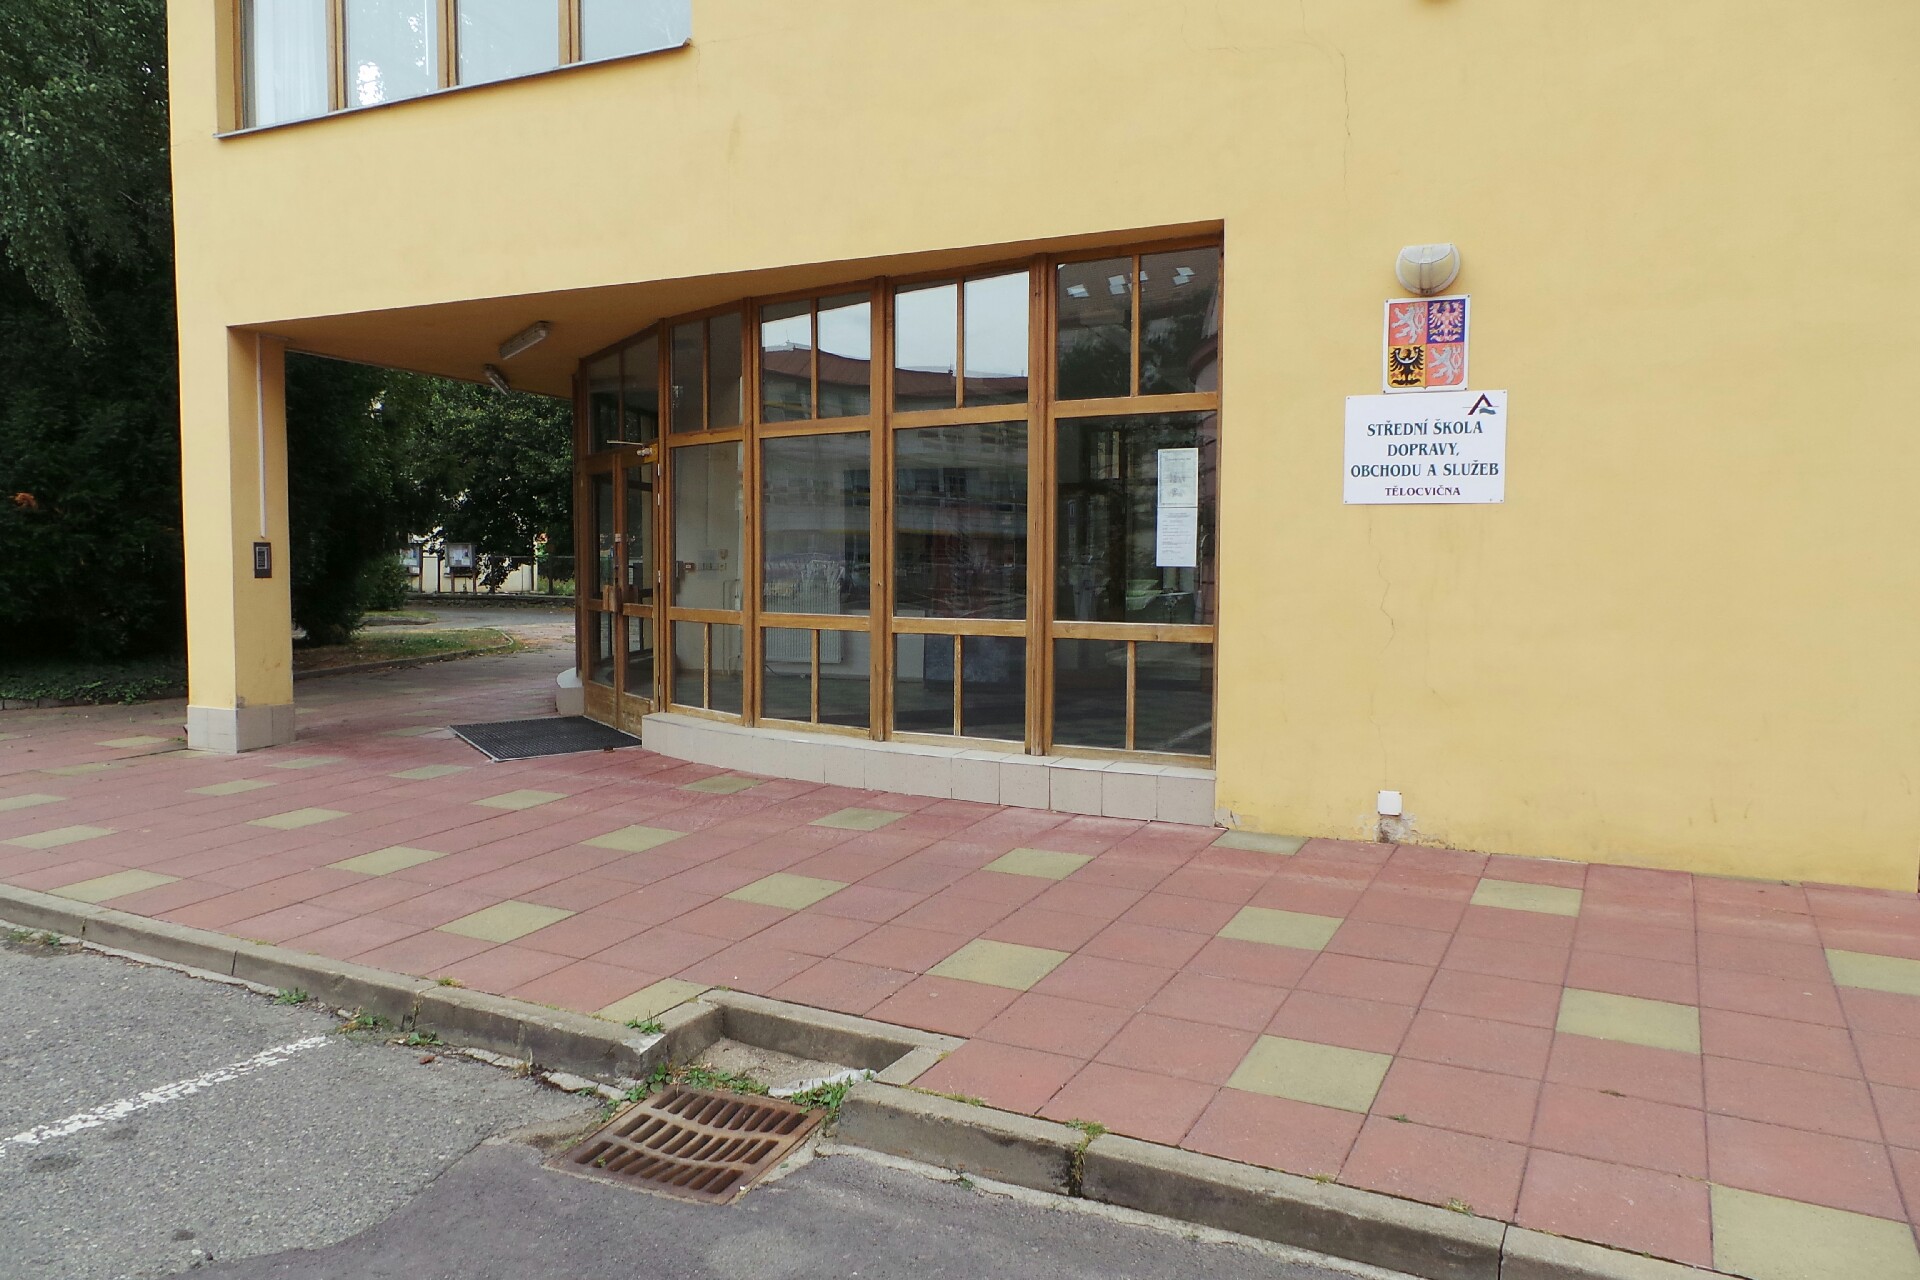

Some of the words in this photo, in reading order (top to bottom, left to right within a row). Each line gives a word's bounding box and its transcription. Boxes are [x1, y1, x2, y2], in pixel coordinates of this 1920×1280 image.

[1367, 419, 1428, 436] STŘEDNÍ
[1432, 419, 1483, 435] ŠKOLA
[1387, 442, 1460, 457] DOPRAVY,
[1350, 463, 1421, 478] OBCHODU
[1427, 464, 1437, 477] A
[1443, 460, 1499, 476] SLUŽEB
[1385, 485, 1461, 497] TĚLOCVIČNA
